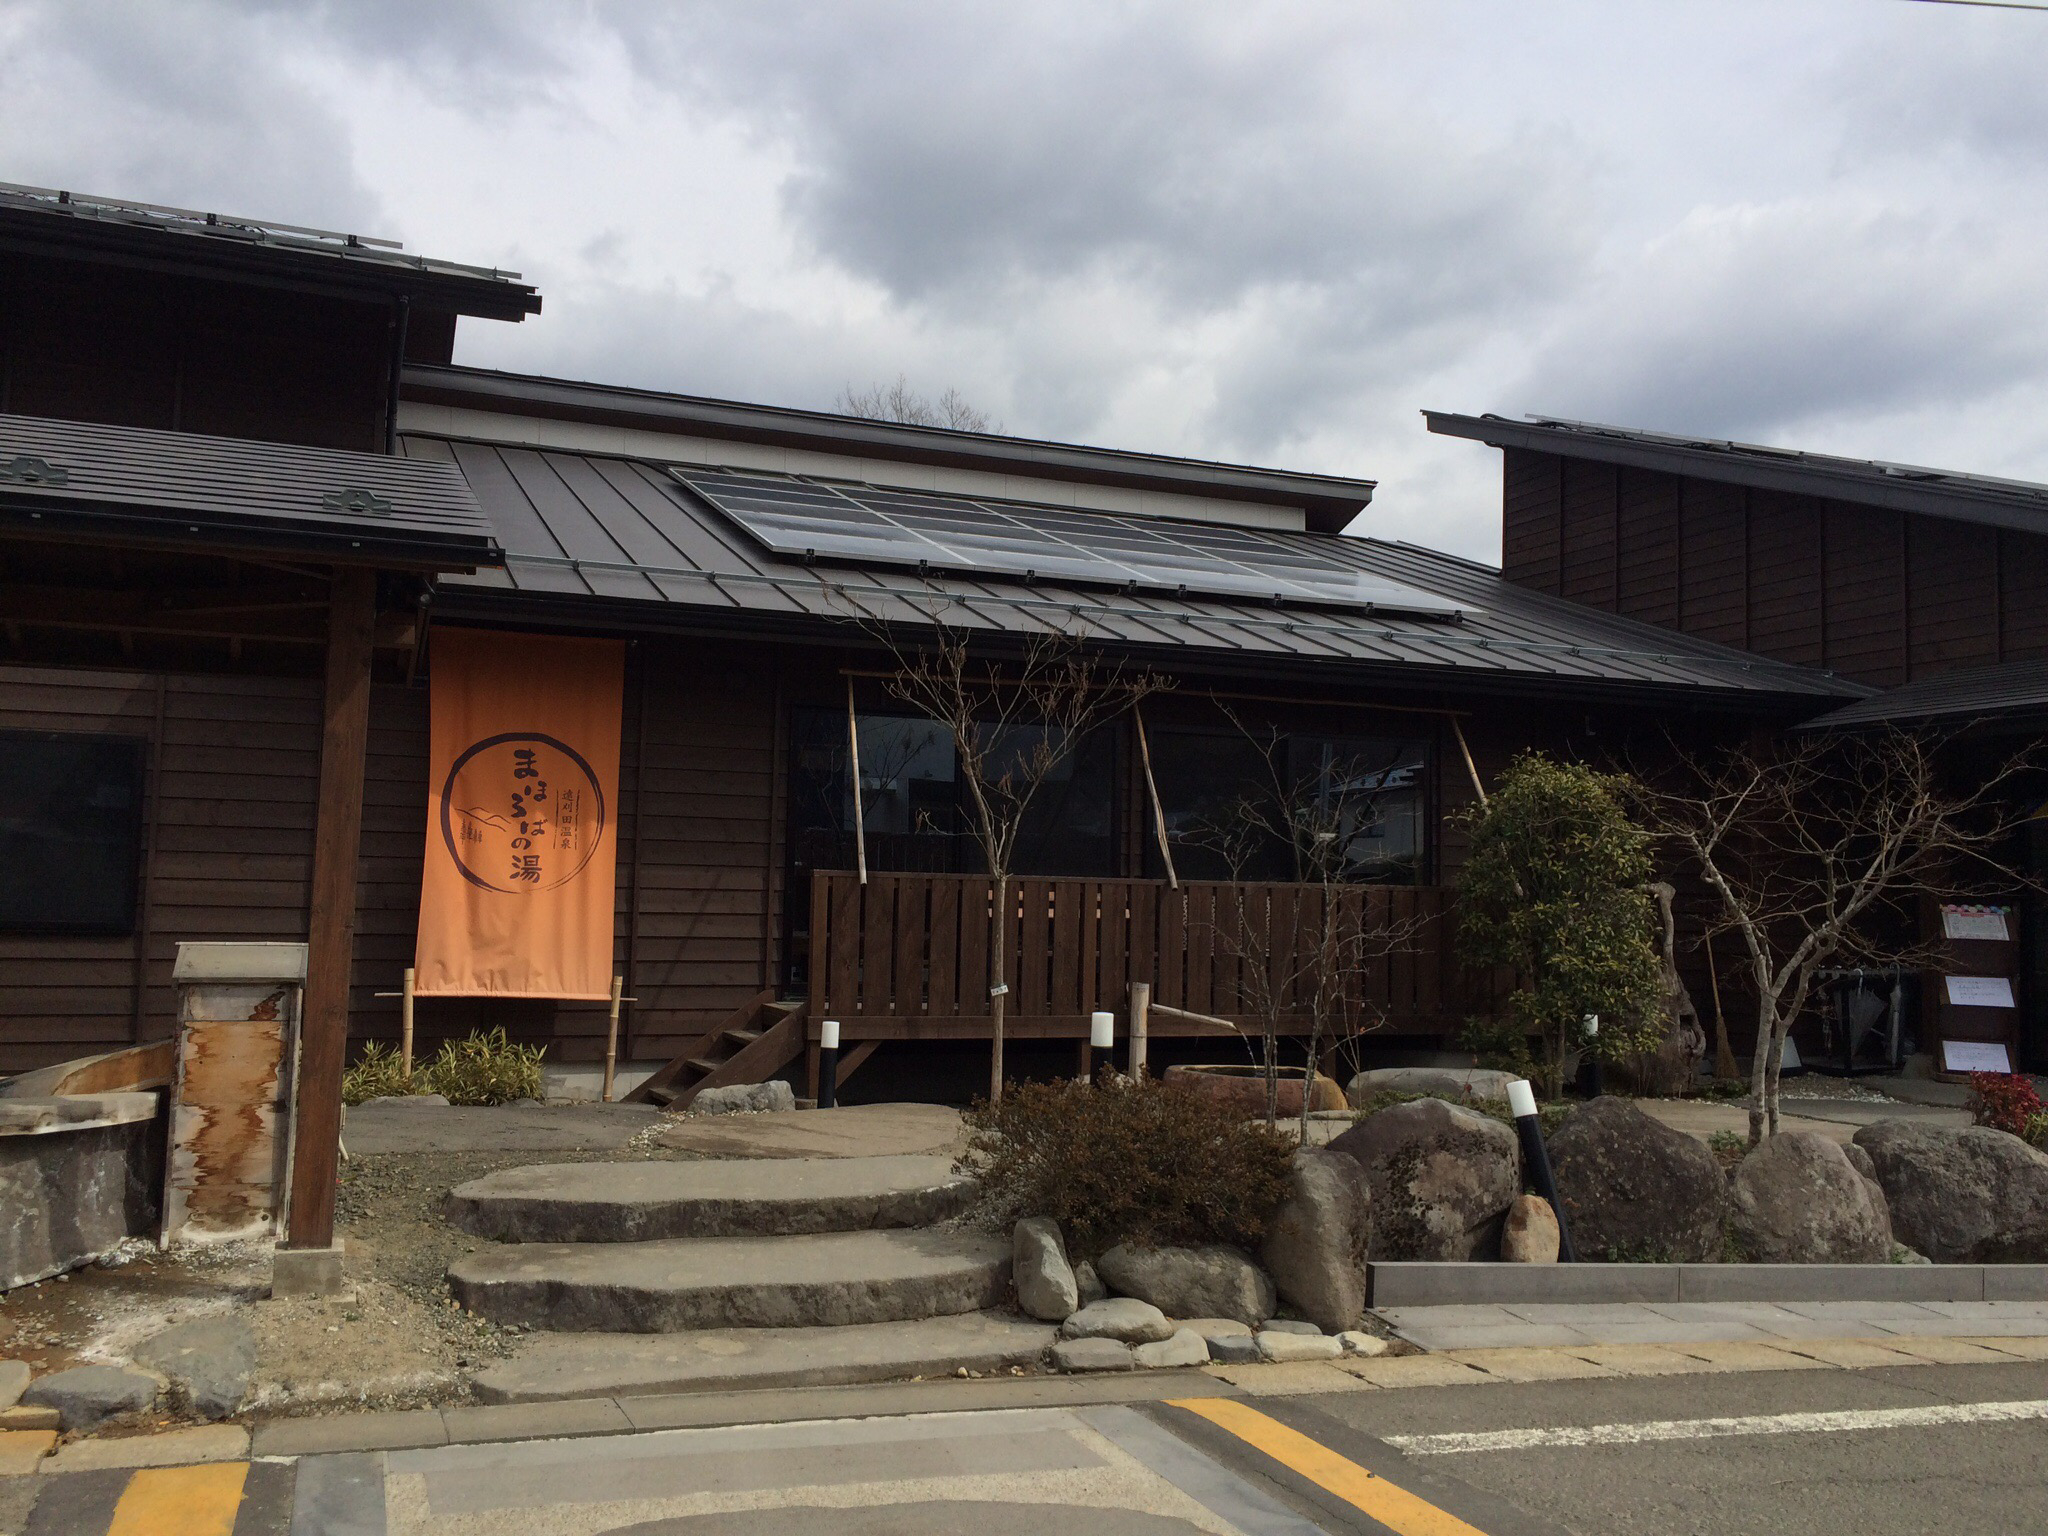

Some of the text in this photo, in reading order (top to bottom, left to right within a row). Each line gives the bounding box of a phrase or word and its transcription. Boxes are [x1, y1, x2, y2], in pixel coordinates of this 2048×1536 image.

[510, 748, 548, 883] まほろばの湯
[560, 789, 574, 850] 遠刈田温泉
